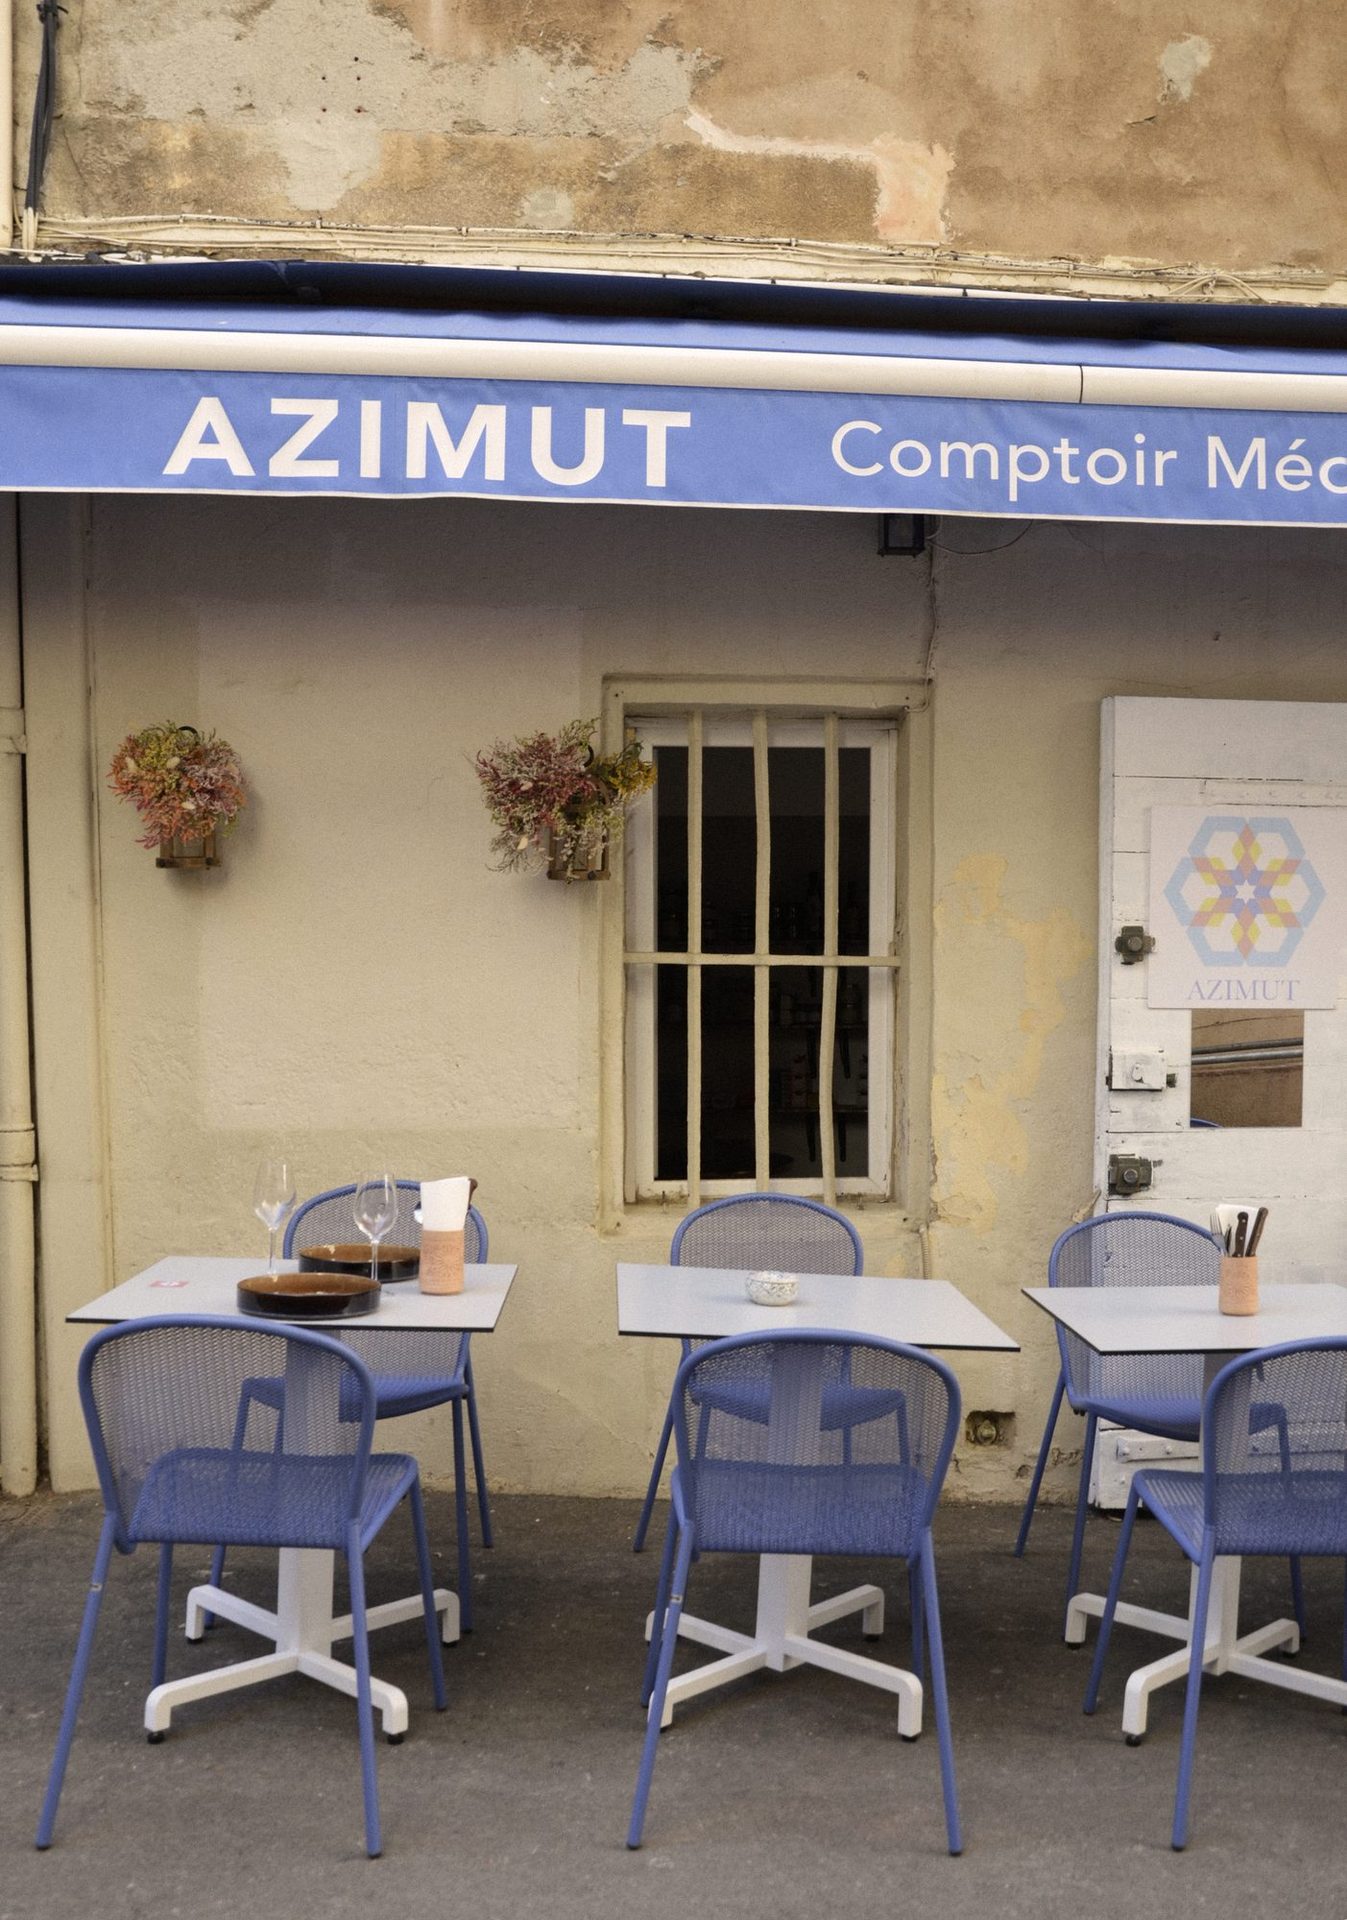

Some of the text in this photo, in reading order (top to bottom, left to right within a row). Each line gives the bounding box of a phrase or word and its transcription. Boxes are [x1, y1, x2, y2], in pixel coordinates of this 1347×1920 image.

[162, 396, 692, 488] AZIMUT
[831, 420, 1178, 502] Comptoir
[1188, 979, 1301, 1001] AZIMUT
